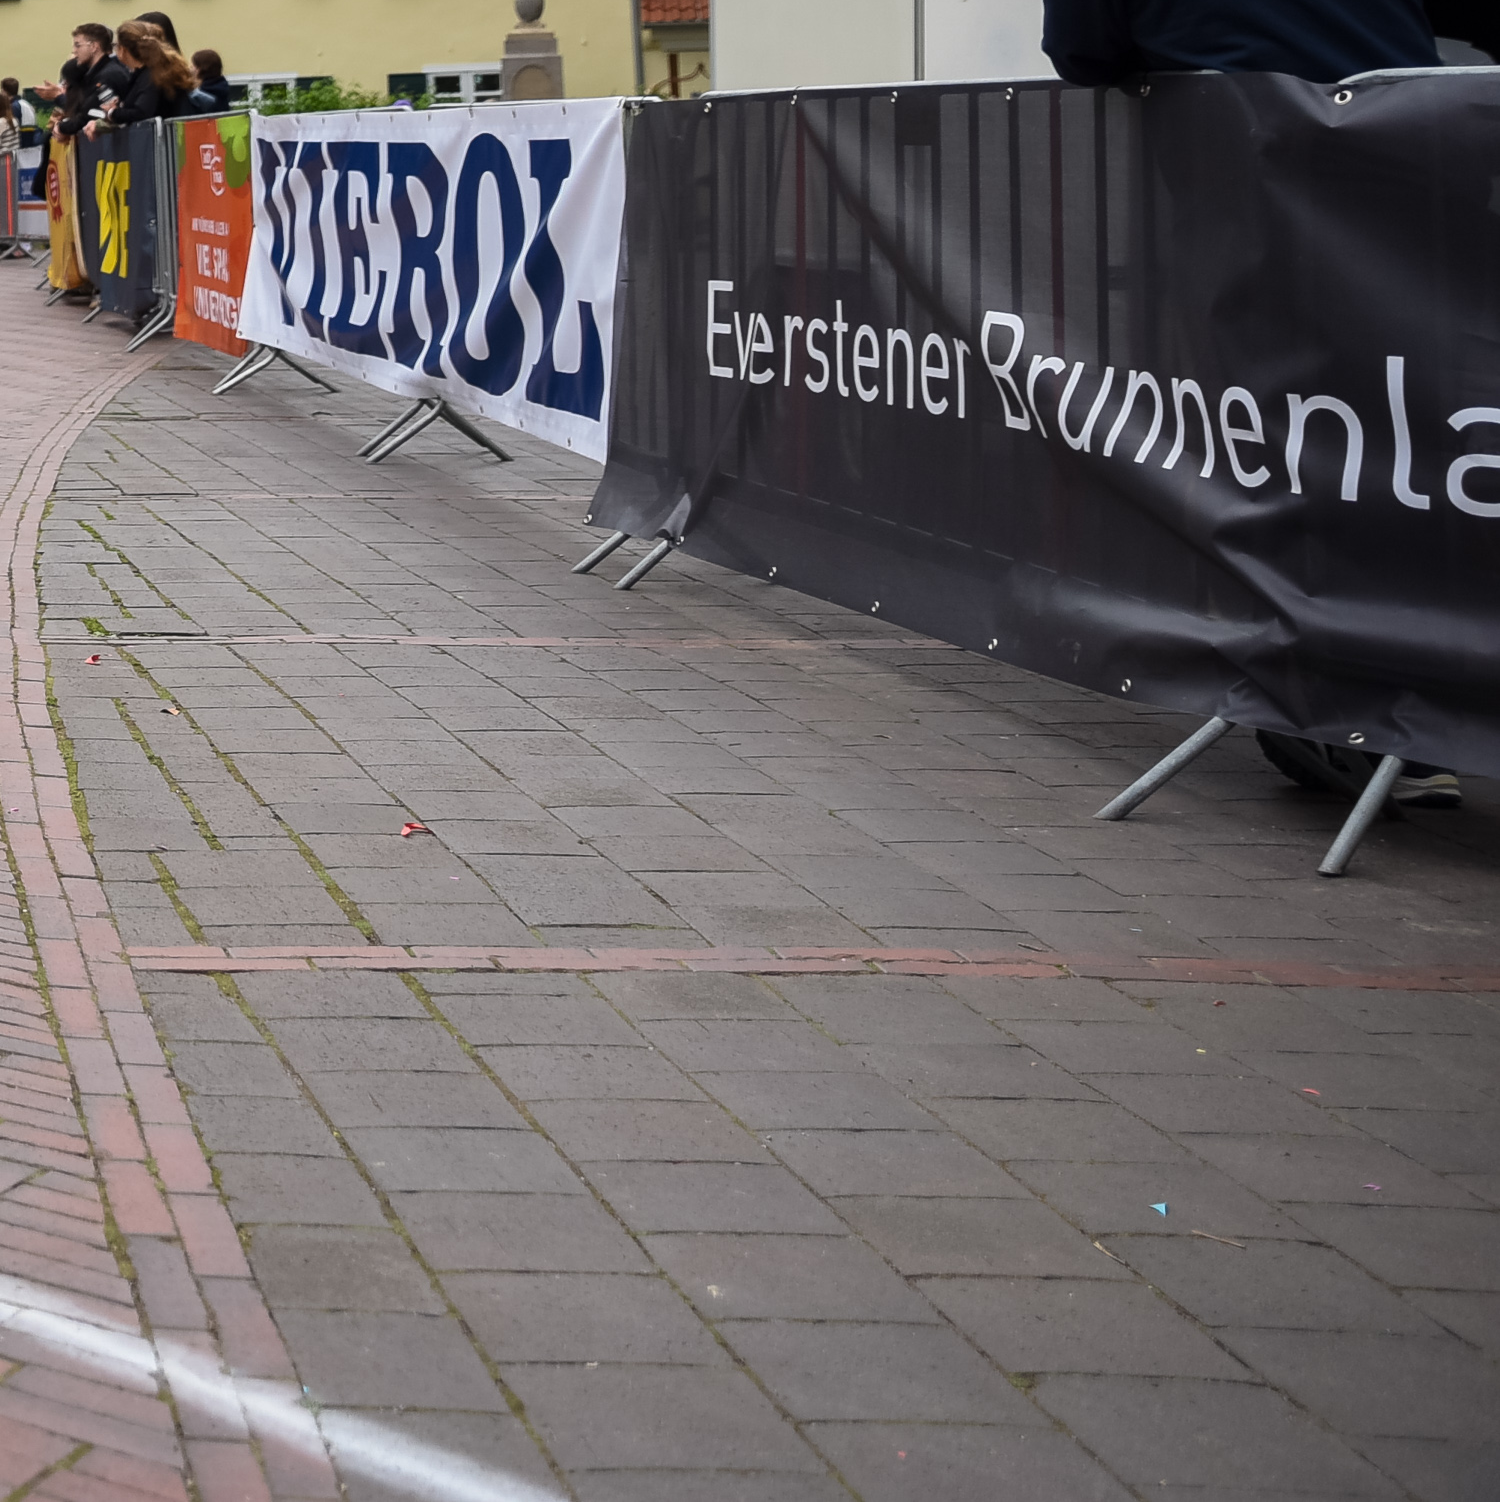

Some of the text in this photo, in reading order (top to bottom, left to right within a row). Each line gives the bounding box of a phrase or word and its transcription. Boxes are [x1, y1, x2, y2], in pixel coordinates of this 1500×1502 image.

[95, 159, 131, 279] WE
[257, 132, 605, 422] VIEROL
[706, 279, 972, 420] Everstener
